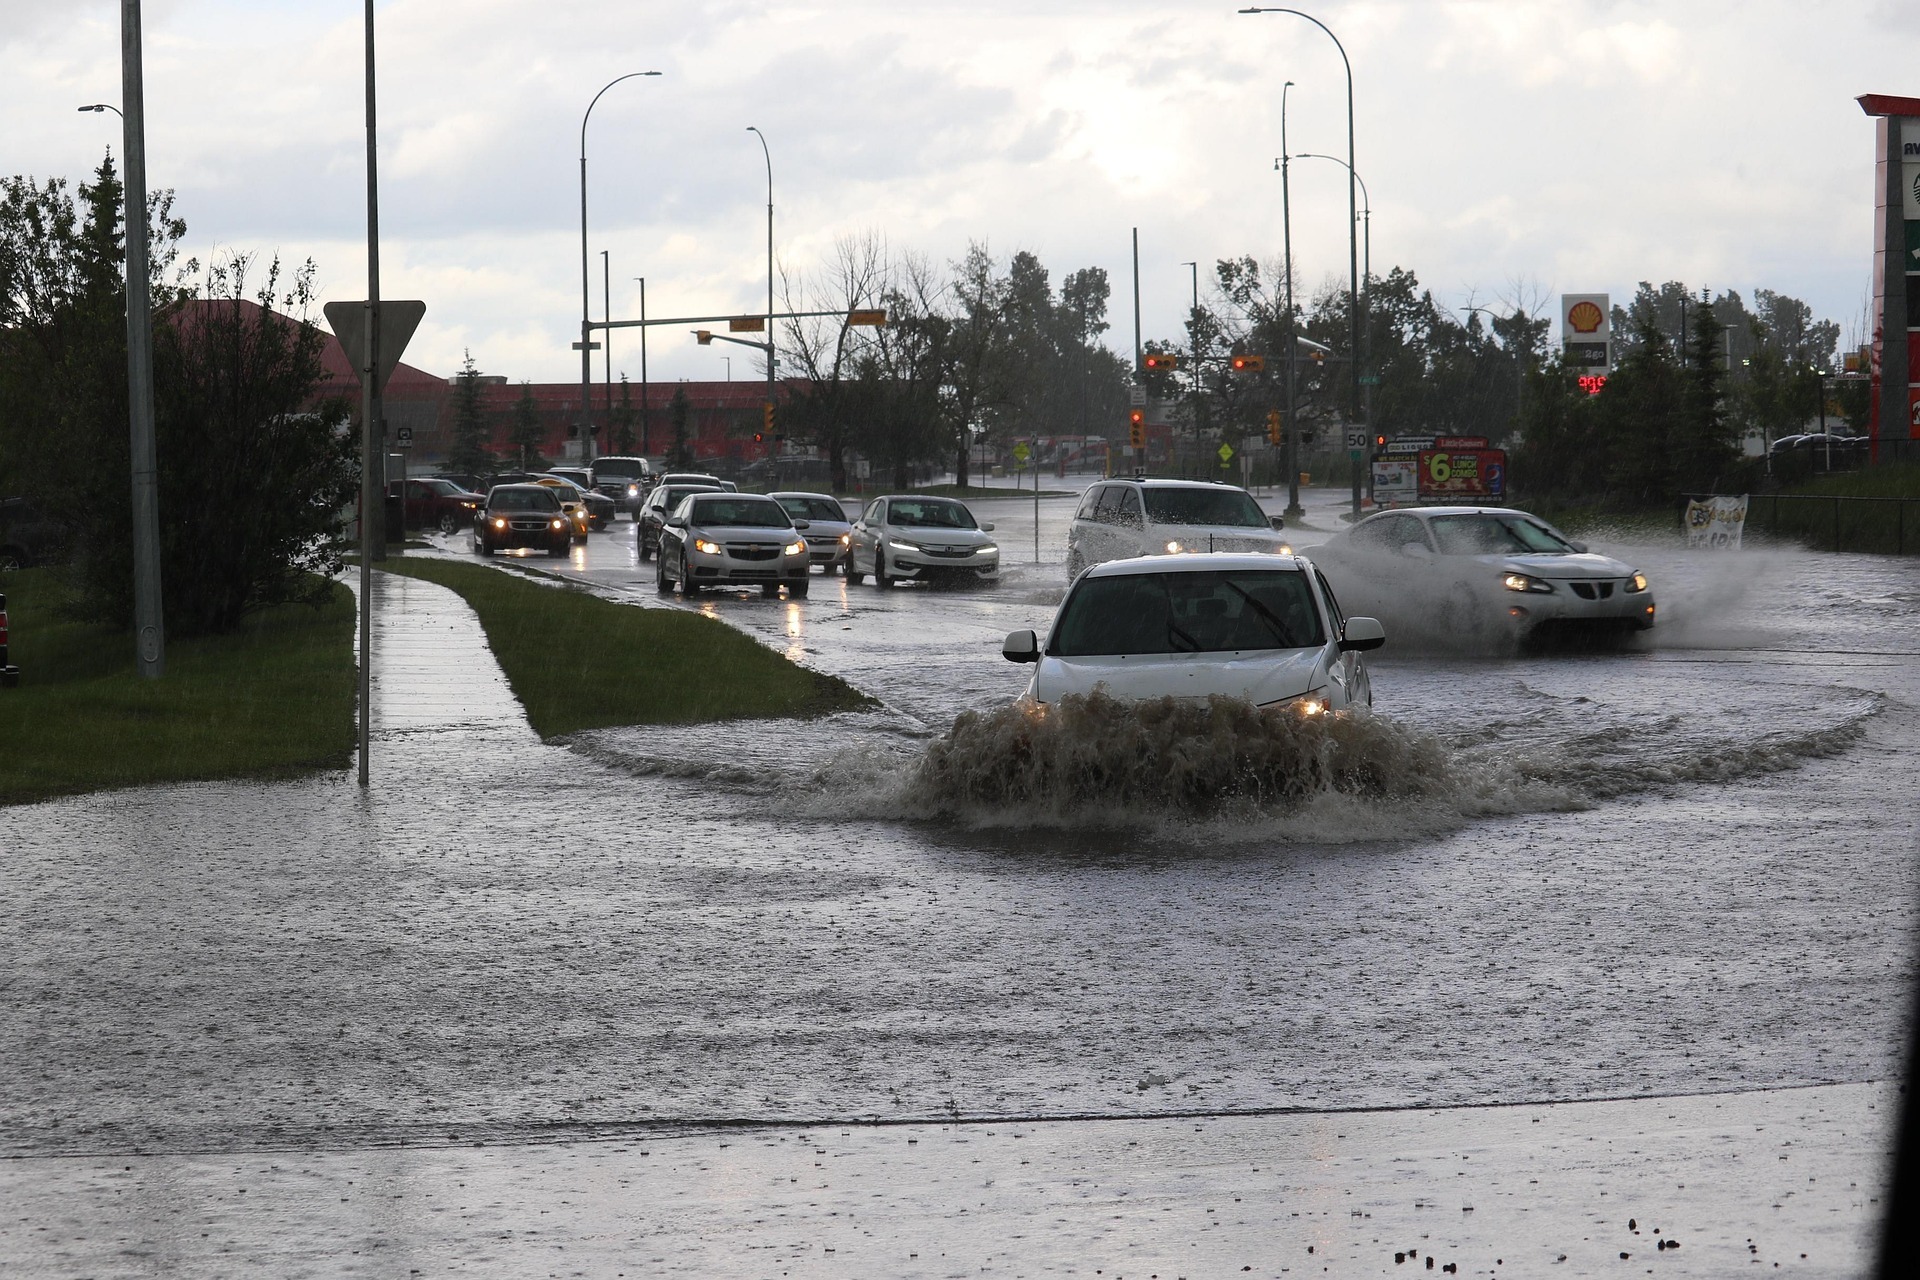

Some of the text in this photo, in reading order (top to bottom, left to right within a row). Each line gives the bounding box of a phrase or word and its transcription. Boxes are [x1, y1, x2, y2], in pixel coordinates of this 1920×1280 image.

[1348, 434, 1366, 447] 50
[1452, 460, 1478, 469] LUNCH
[1451, 469, 1478, 478] COMBO
